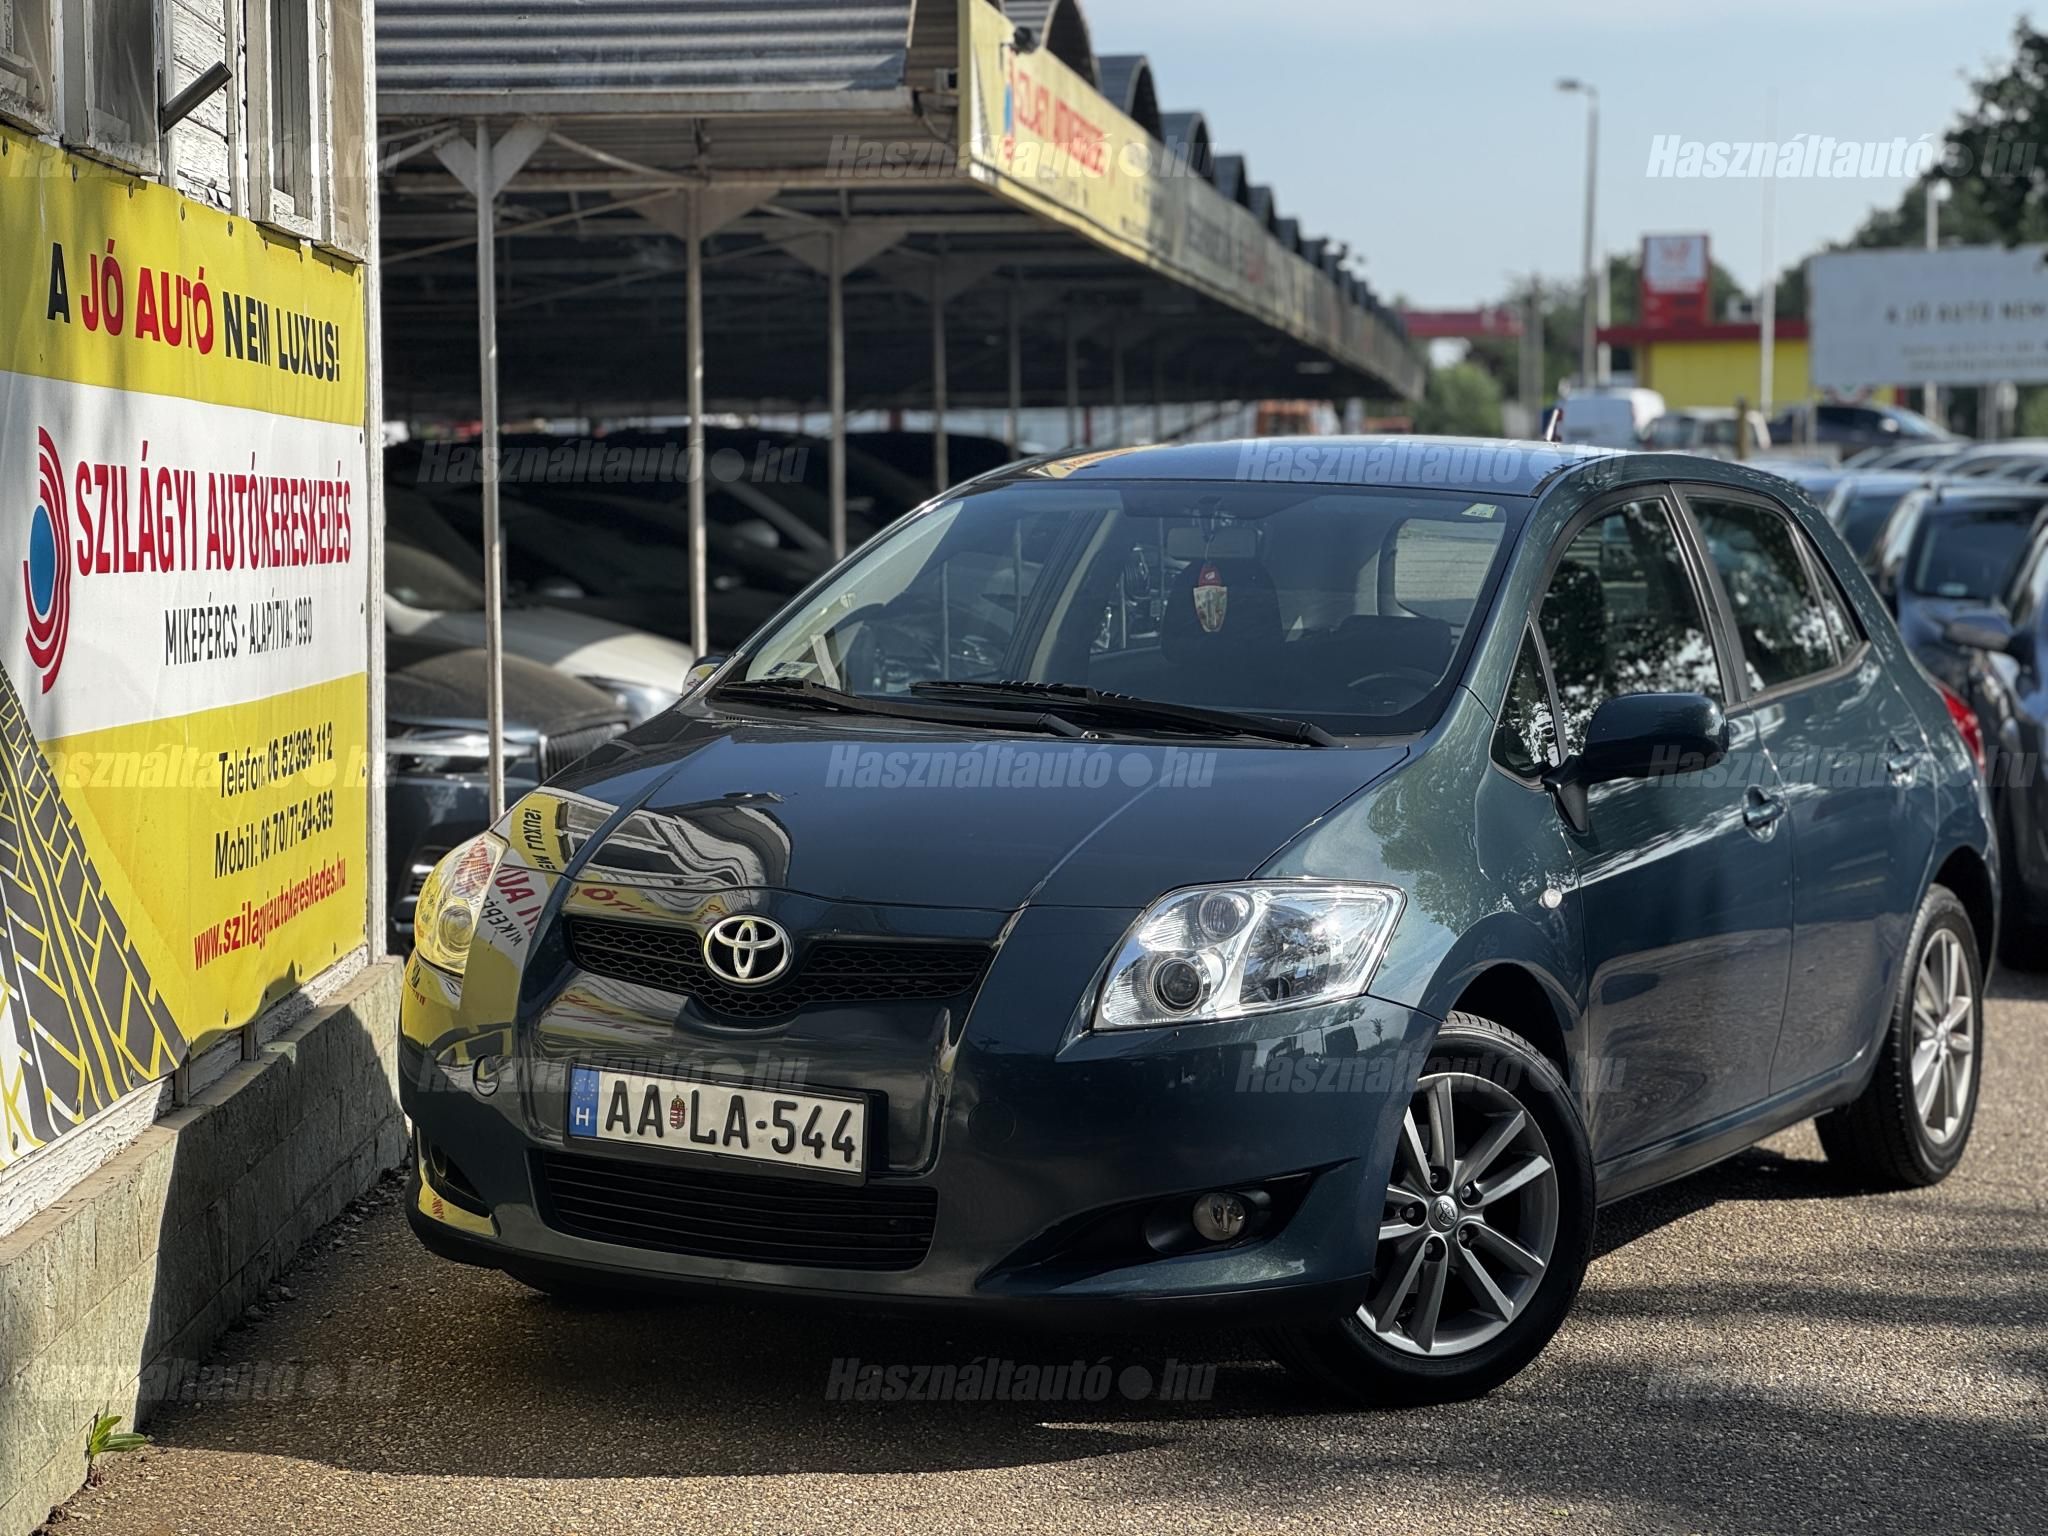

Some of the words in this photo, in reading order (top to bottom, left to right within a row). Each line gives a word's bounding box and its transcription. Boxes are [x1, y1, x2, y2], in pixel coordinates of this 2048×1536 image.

[47, 242, 71, 324] A
[81, 239, 124, 336] JÓ
[135, 266, 214, 355] AUTÓ
[223, 291, 271, 366] NEM
[276, 307, 340, 382] LUXUS!
[75, 440, 198, 577] SZILÁGYI
[206, 451, 351, 571] AUTÓKERESKEDÉS
[165, 592, 238, 666] MIKEPÉRCS
[249, 587, 293, 655] ALAPÍTVA:
[295, 596, 313, 646] 1990
[219, 747, 266, 798] Telefon:
[268, 739, 279, 784] 06
[214, 823, 258, 879] Mobil:
[261, 816, 270, 863] 06
[194, 851, 346, 971] www.szilagyiautokereskedes.hu
[574, 1106, 590, 1127] H
